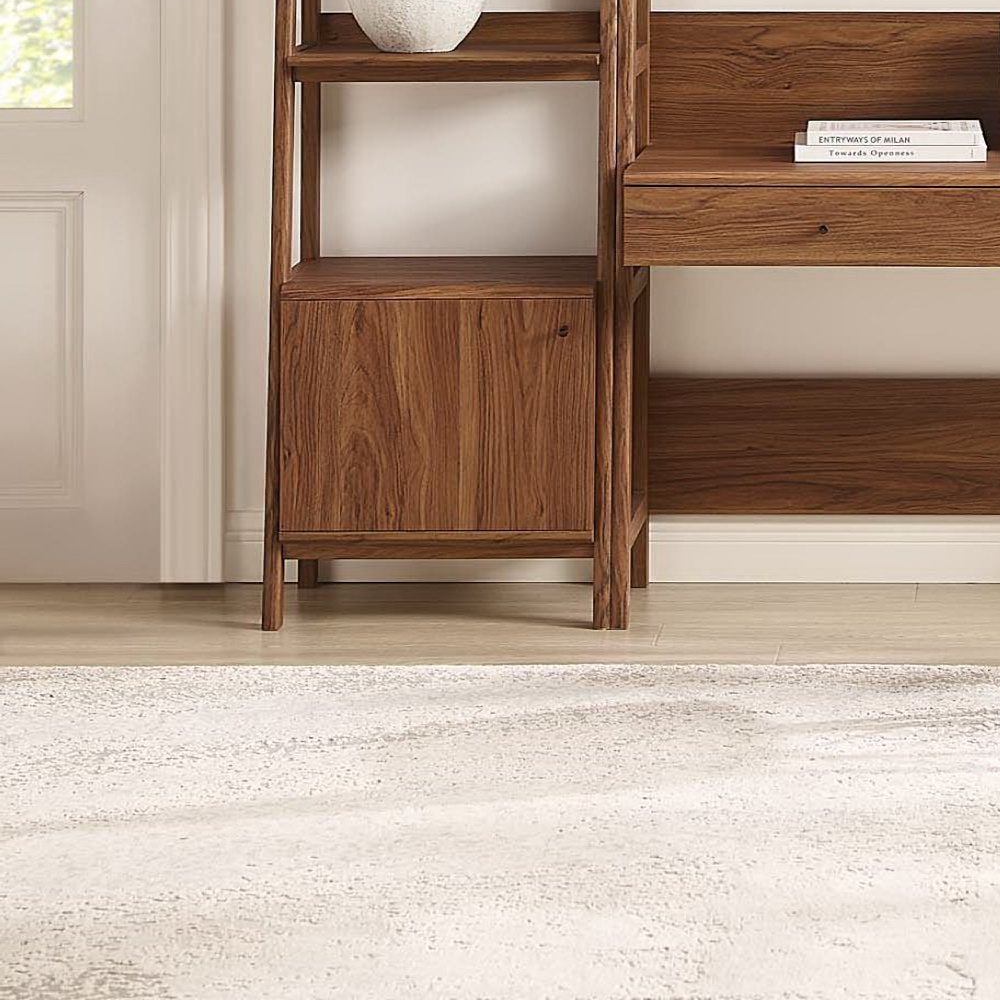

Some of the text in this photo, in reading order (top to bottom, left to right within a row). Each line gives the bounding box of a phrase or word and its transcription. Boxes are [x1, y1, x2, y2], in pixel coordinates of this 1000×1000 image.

[818, 136, 911, 144] ENTRYWAYS OF MILAN
[829, 149, 915, 158] Towards Openness
